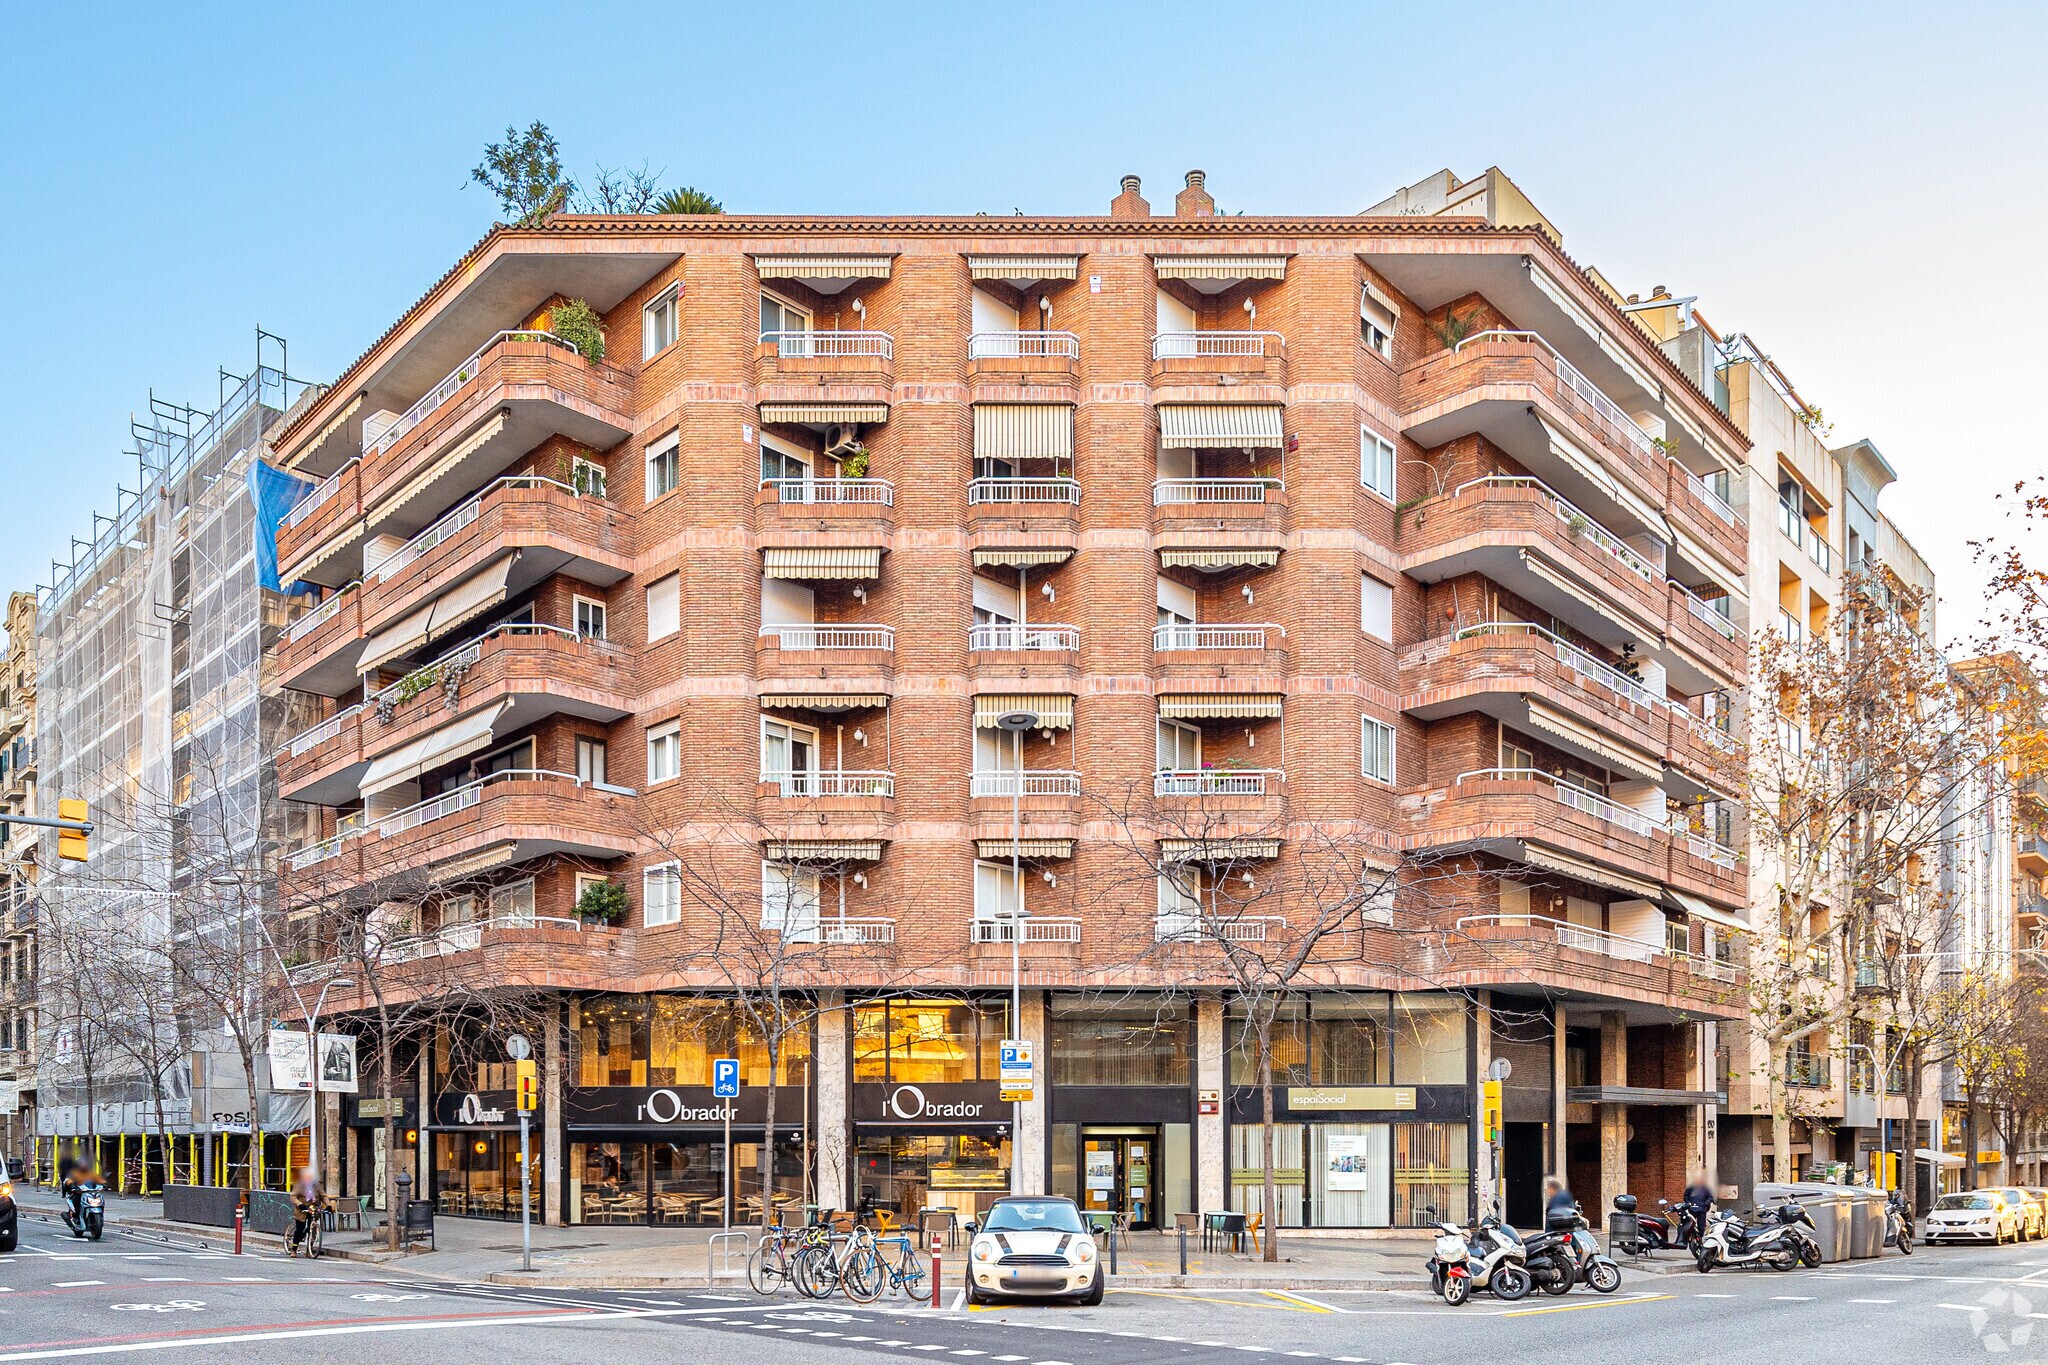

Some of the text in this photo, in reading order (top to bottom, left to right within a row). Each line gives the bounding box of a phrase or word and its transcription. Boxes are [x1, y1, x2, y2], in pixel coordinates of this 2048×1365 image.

[1004, 1049, 1014, 1061] P
[720, 1064, 734, 1081] P
[882, 1085, 984, 1119] l'Obrador
[1293, 1093, 1346, 1105] espaiSocial
